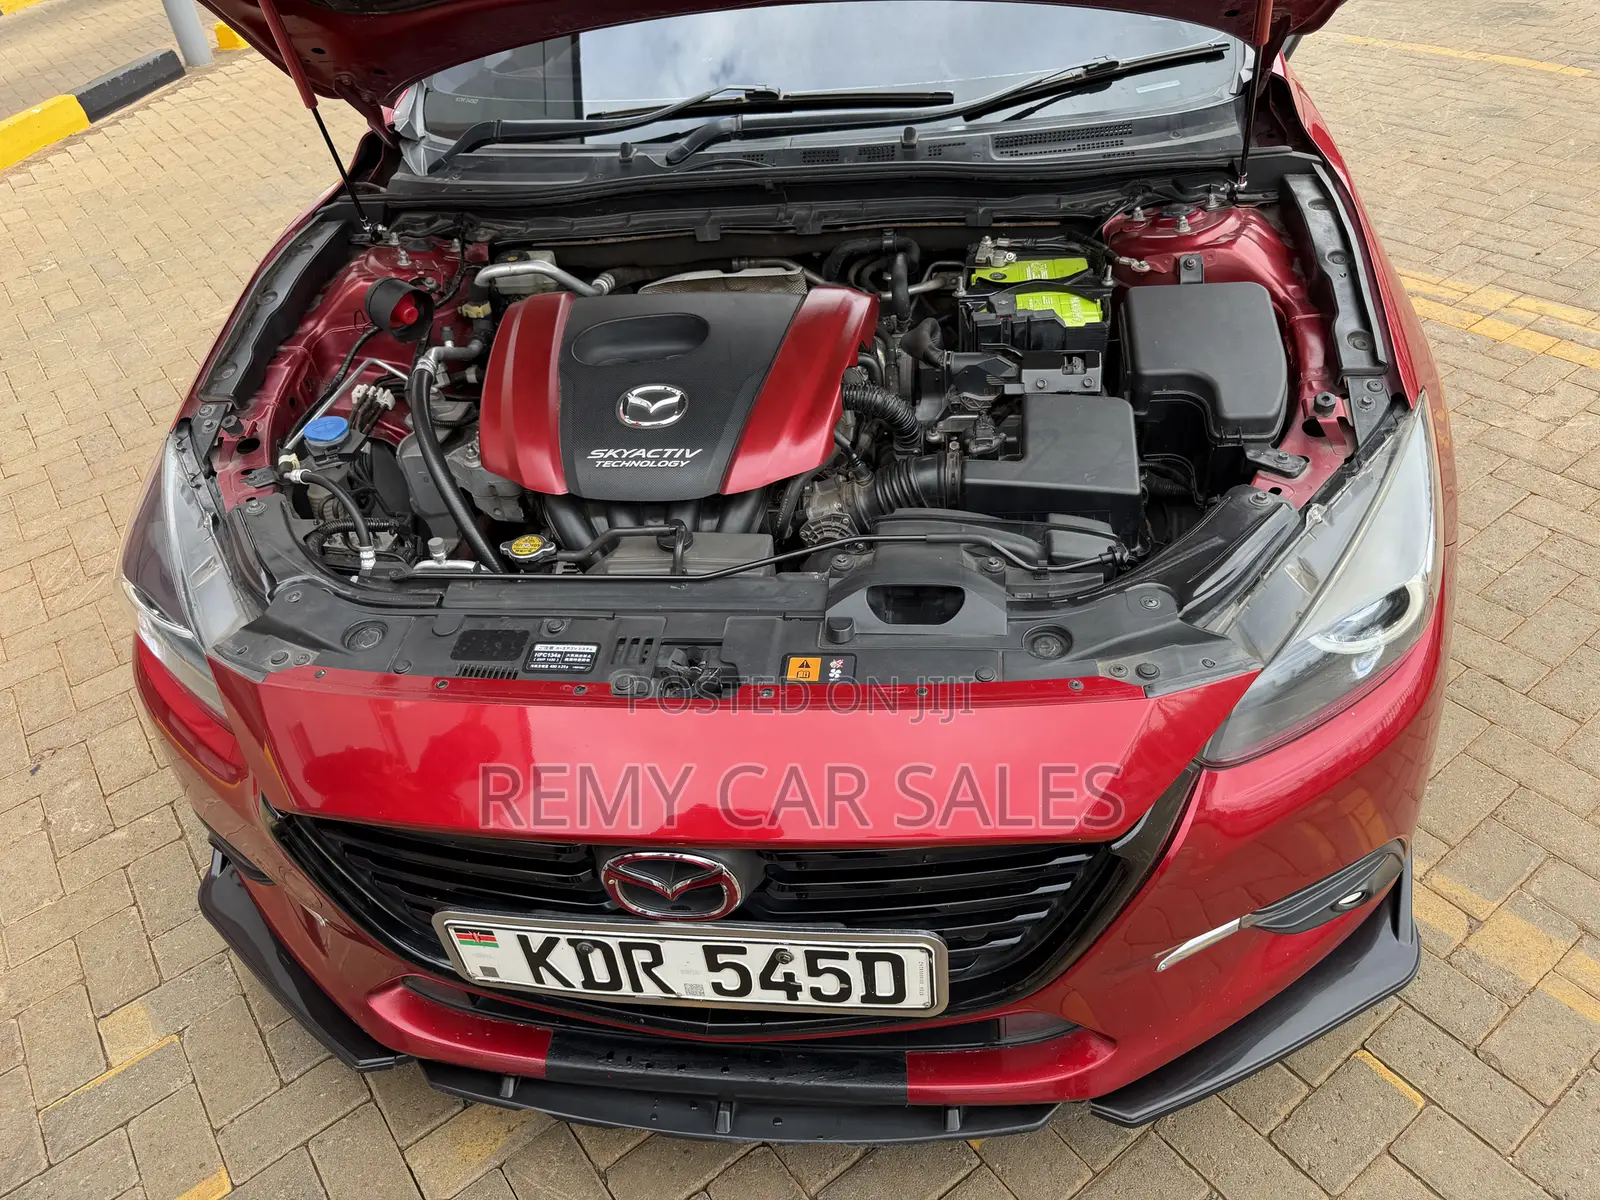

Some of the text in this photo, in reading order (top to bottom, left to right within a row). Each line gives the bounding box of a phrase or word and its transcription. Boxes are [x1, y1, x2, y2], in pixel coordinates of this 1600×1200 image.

[586, 448, 703, 459] SKYACTIV
[595, 460, 691, 468] TECHNOLOGY
[516, 934, 679, 995] KDR
[701, 944, 907, 1005] 545D
